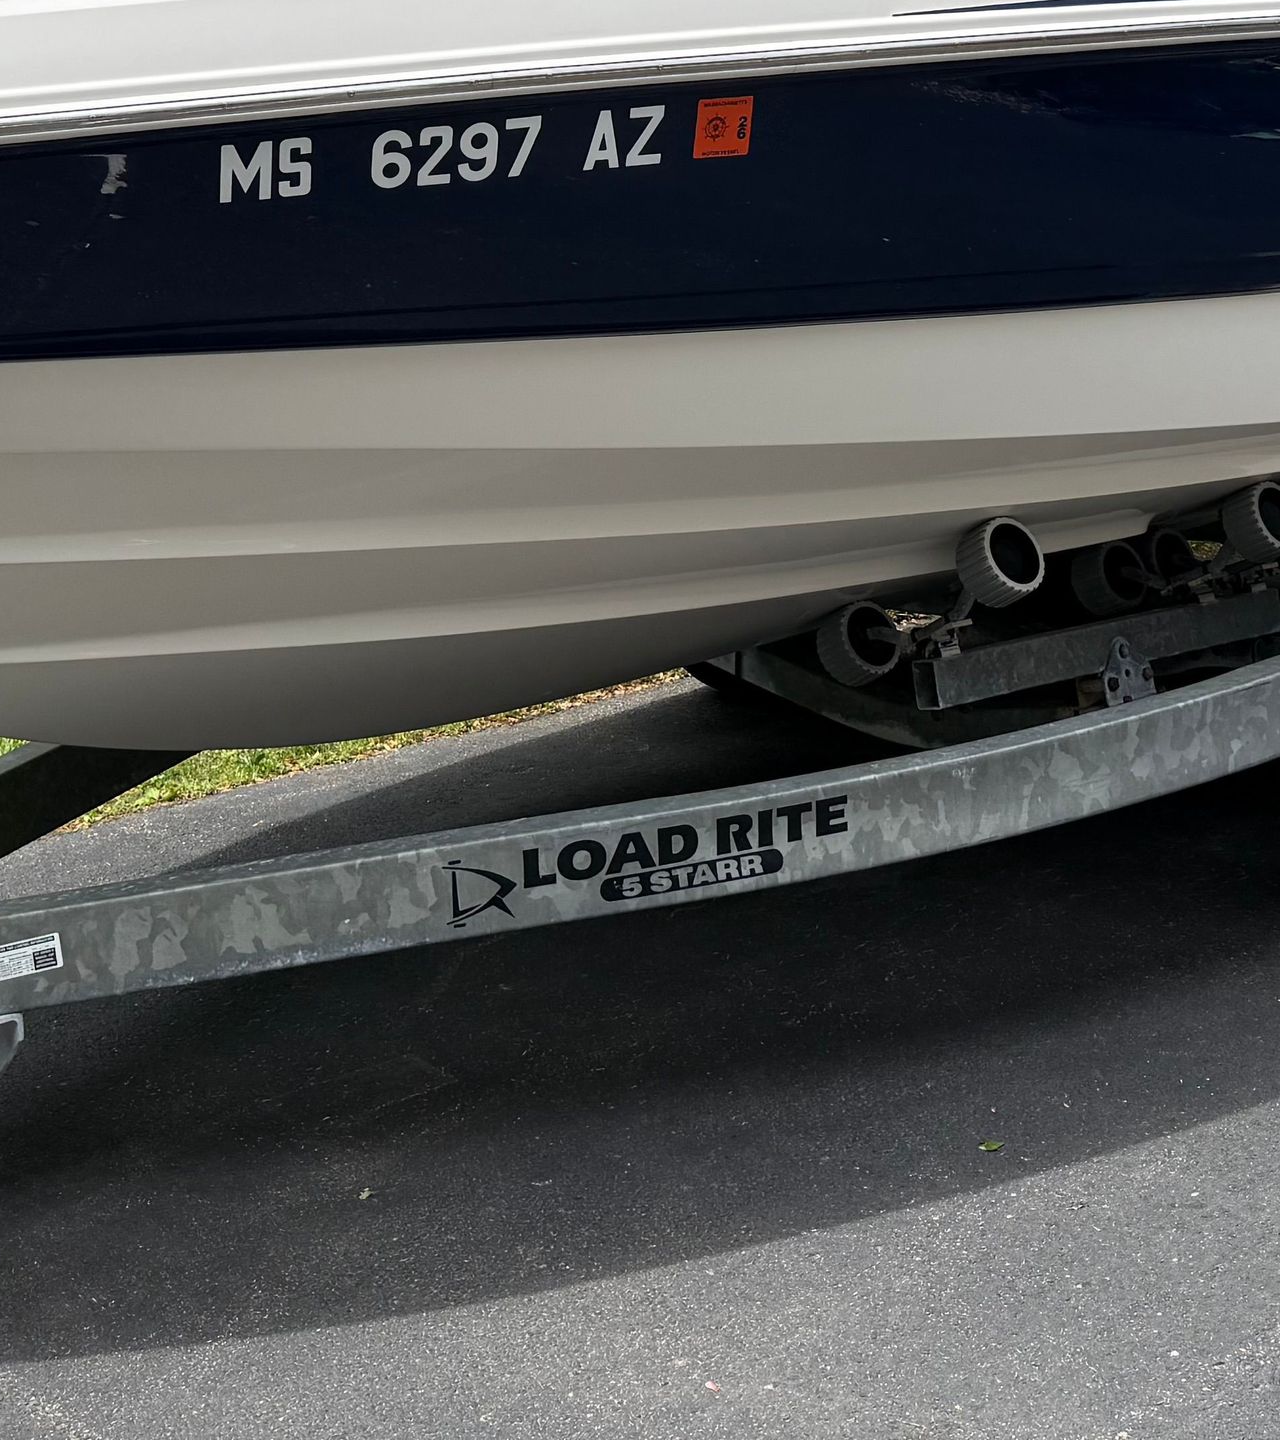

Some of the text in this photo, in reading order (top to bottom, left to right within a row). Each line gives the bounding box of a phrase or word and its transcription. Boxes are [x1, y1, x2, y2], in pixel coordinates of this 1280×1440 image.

[220, 105, 665, 203] MS 6297 AZ
[522, 795, 849, 888] LOAD RITE
[618, 854, 766, 898] 5 STARR
